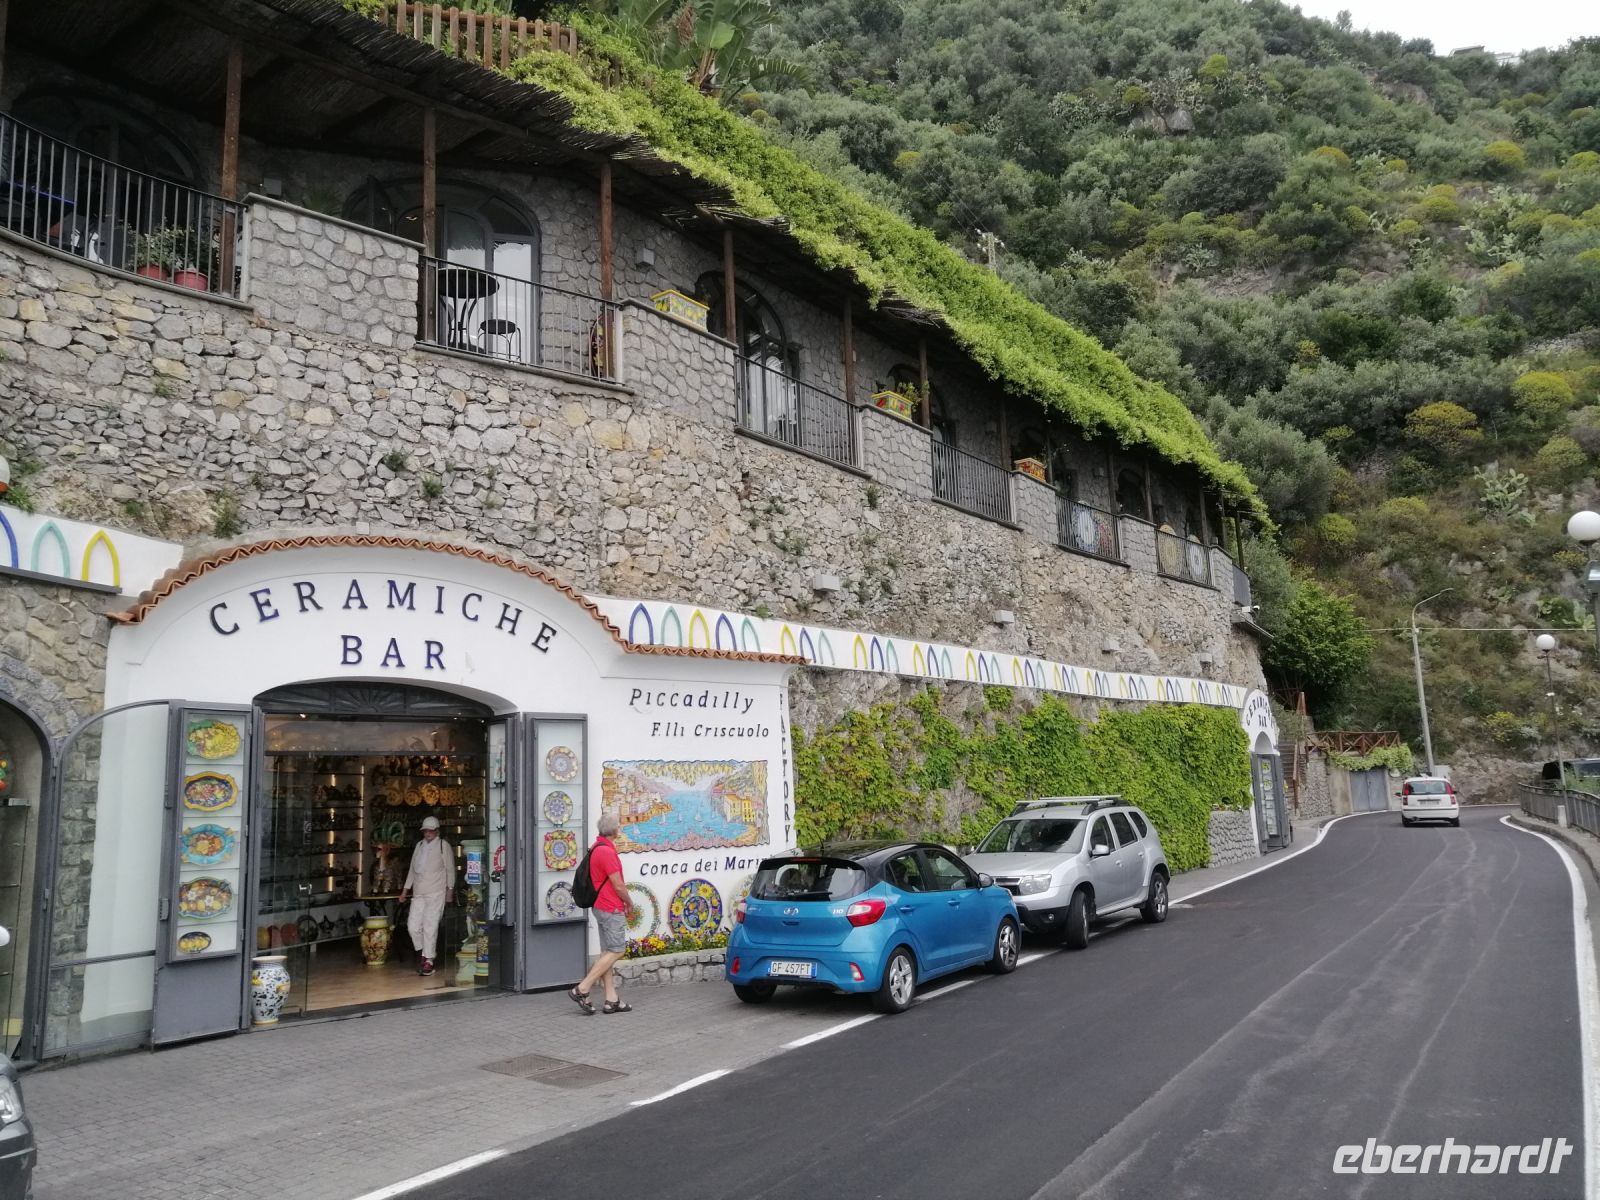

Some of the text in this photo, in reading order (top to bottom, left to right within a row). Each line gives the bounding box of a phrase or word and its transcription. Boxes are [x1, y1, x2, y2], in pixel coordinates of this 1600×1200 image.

[209, 578, 558, 654] CERAMICHE
[340, 634, 446, 671] BAR
[628, 688, 754, 715] Piccadilly
[694, 723, 770, 738] Criscuolo
[779, 692, 791, 843] FACTORY
[639, 862, 689, 876] Conca
[694, 858, 719, 872] dei
